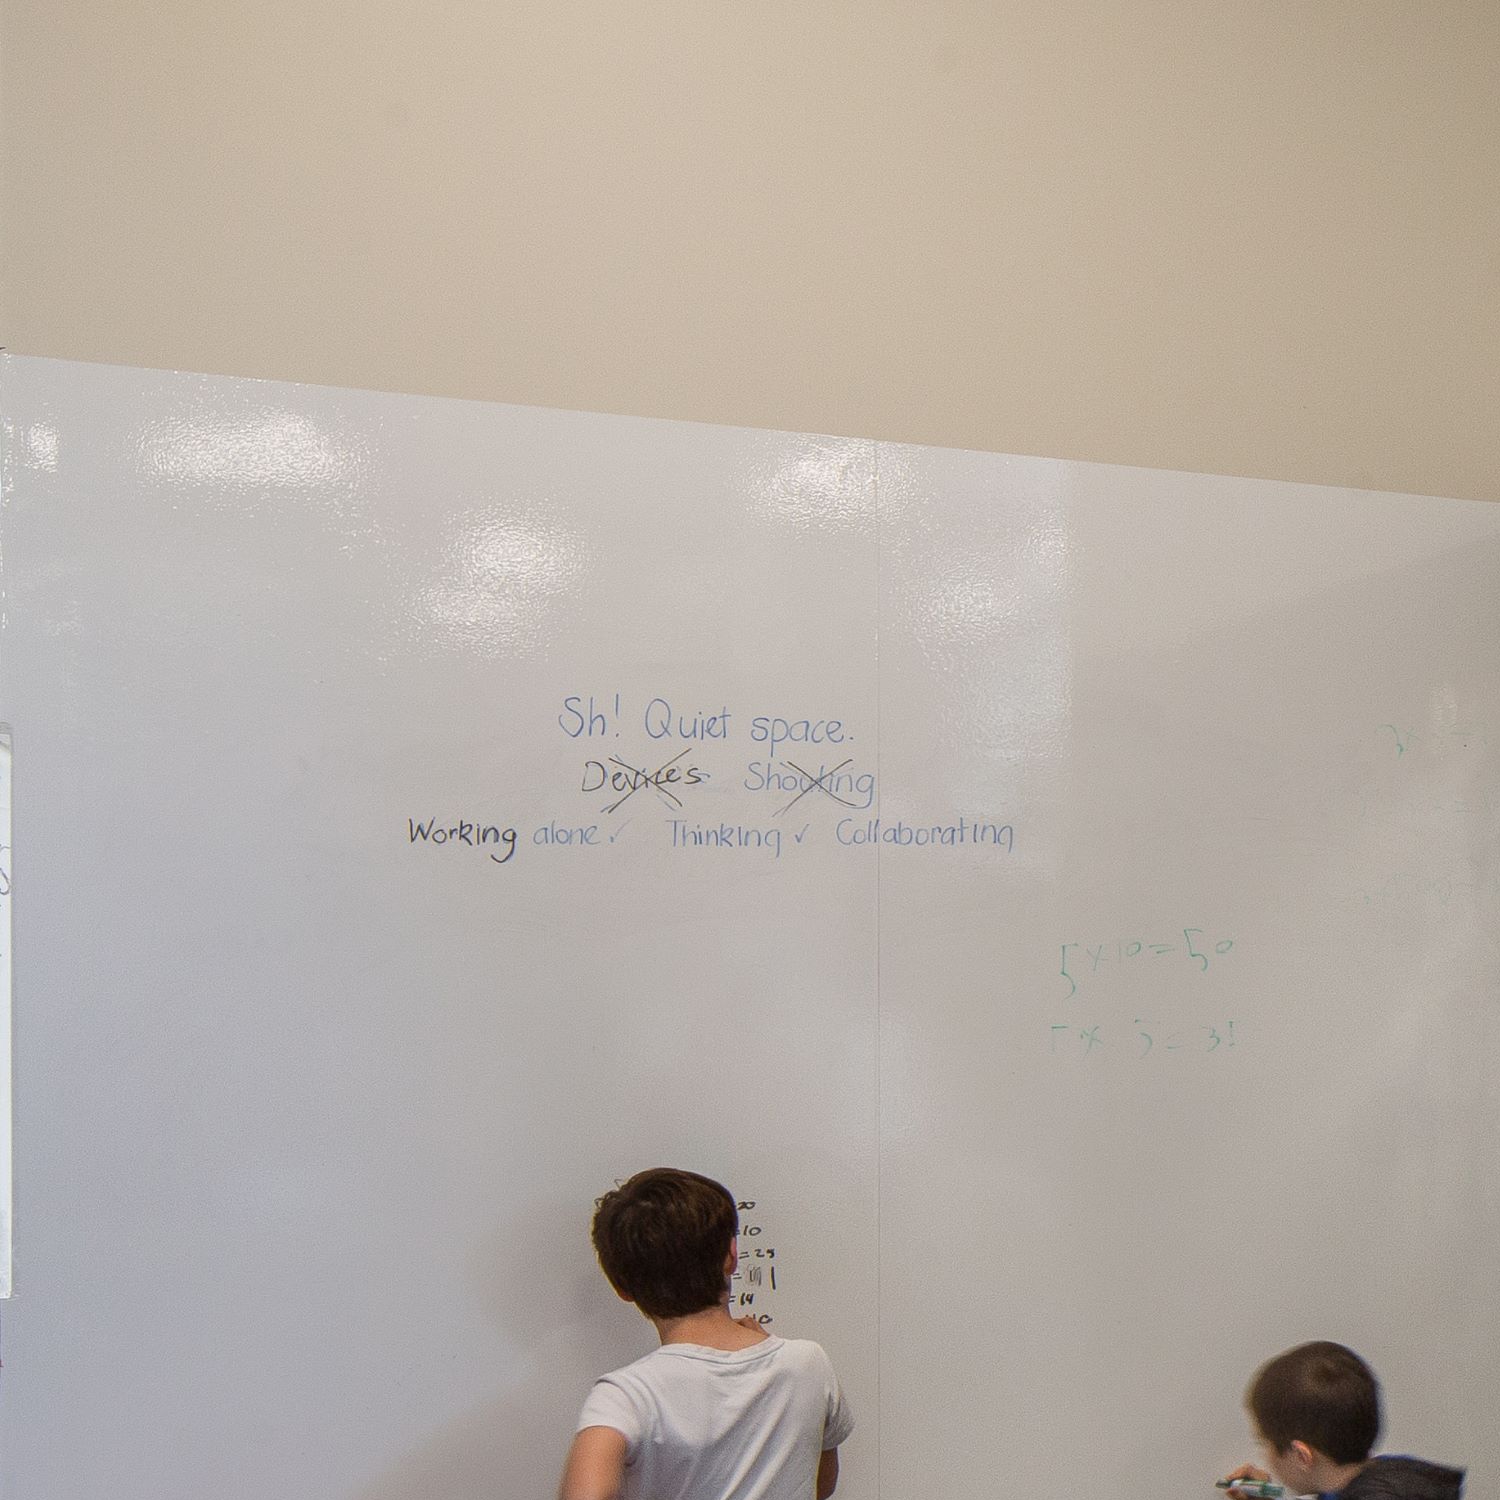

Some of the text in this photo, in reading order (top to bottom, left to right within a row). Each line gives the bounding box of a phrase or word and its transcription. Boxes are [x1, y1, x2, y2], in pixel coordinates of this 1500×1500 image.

[558, 695, 856, 753] Sh! Quiet space.
[408, 818, 1014, 864] Working alone Thinking Collaborating
